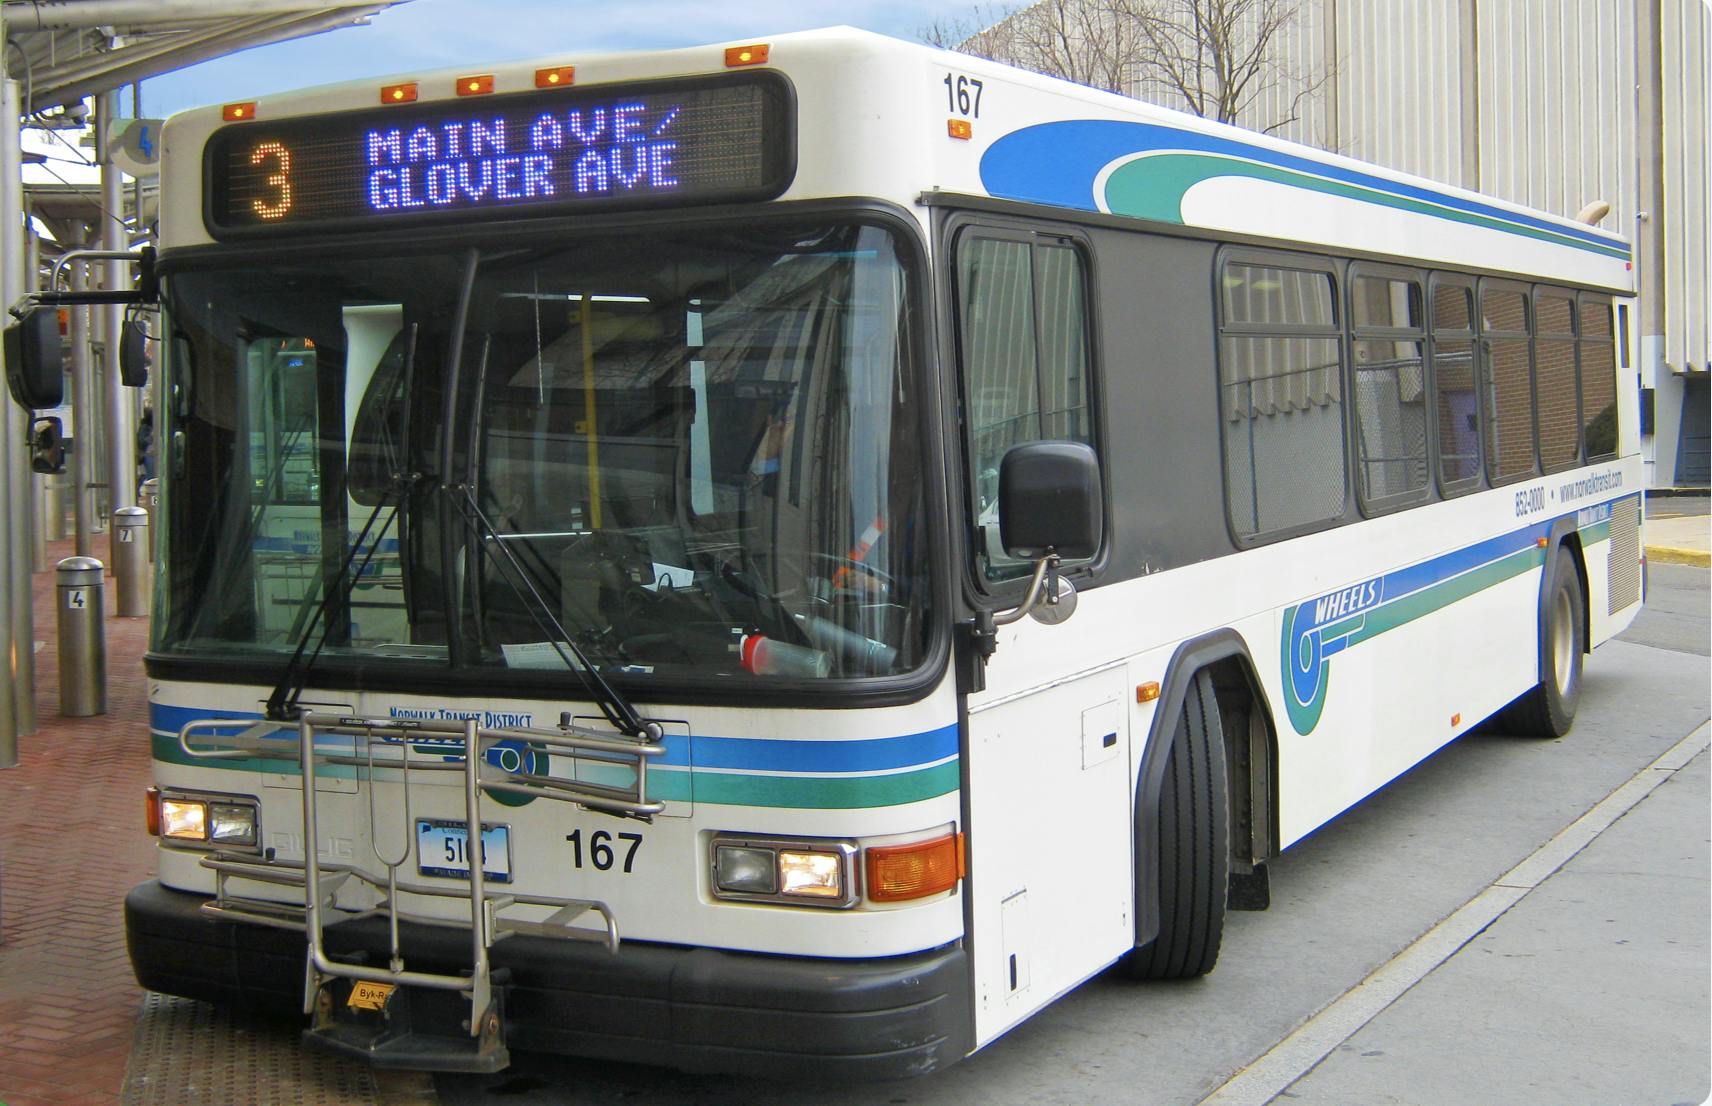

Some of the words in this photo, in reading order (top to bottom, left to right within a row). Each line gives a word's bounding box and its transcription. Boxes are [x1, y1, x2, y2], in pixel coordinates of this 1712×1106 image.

[944, 72, 983, 119] 167
[368, 118, 506, 166] MAIN
[252, 142, 292, 219] 3
[369, 154, 555, 209] GLOVER
[577, 143, 679, 193] AVE
[1515, 486, 1545, 517] 852-0000
[121, 529, 129, 541] 7
[72, 591, 84, 607] 4
[1314, 580, 1376, 624] WHEELS
[485, 711, 532, 729] DISTRICT
[566, 829, 643, 873] 167
